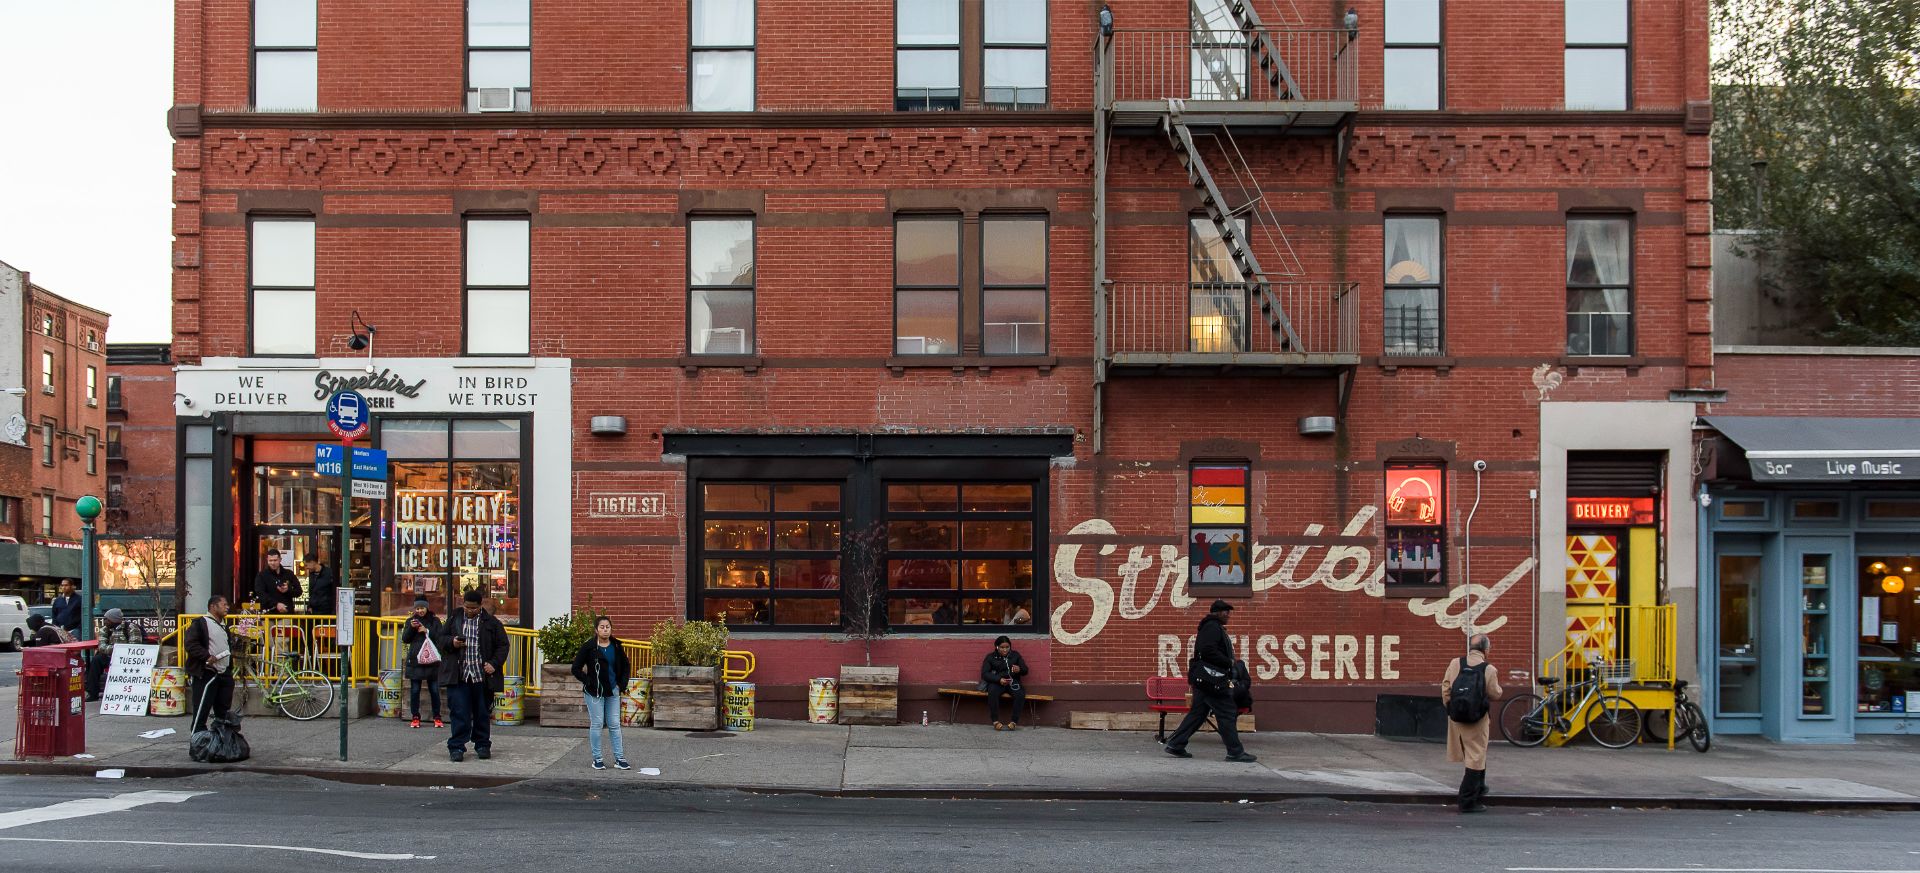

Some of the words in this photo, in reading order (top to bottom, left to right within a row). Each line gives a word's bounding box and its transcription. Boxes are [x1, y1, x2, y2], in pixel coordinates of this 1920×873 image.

[239, 376, 264, 388] WE
[314, 368, 427, 401] Streetbird
[458, 376, 478, 389] IN
[484, 376, 528, 389] BIRD
[215, 393, 287, 405] DELIVER
[449, 393, 474, 406] WE
[481, 393, 538, 406] TRUST
[330, 422, 339, 432] NO
[338, 425, 367, 438] STANDING
[317, 447, 333, 458] M7
[317, 461, 342, 474] M116
[1766, 461, 1793, 475] Bar
[1827, 461, 1857, 475] Live
[1861, 461, 1902, 475] Music
[597, 496, 637, 513] 116TH
[641, 496, 659, 513] ST
[1193, 485, 1235, 517] Harlem
[400, 496, 501, 521] DELIVERY
[1576, 503, 1630, 518] DELIVERY
[401, 549, 429, 567] ICE
[440, 549, 500, 568] CREAM
[1051, 504, 1539, 646] Stretbd
[143, 617, 176, 627] Staon
[127, 648, 146, 656] TACO
[1158, 634, 1401, 680] RISSERIE
[119, 656, 153, 666] TUESDAY!
[108, 675, 151, 684] MARGARITAS
[150, 689, 172, 700] RLEM
[734, 686, 744, 695] IN
[728, 696, 750, 707] BIRD
[730, 706, 743, 716] WE
[726, 718, 752, 728] TRUST
